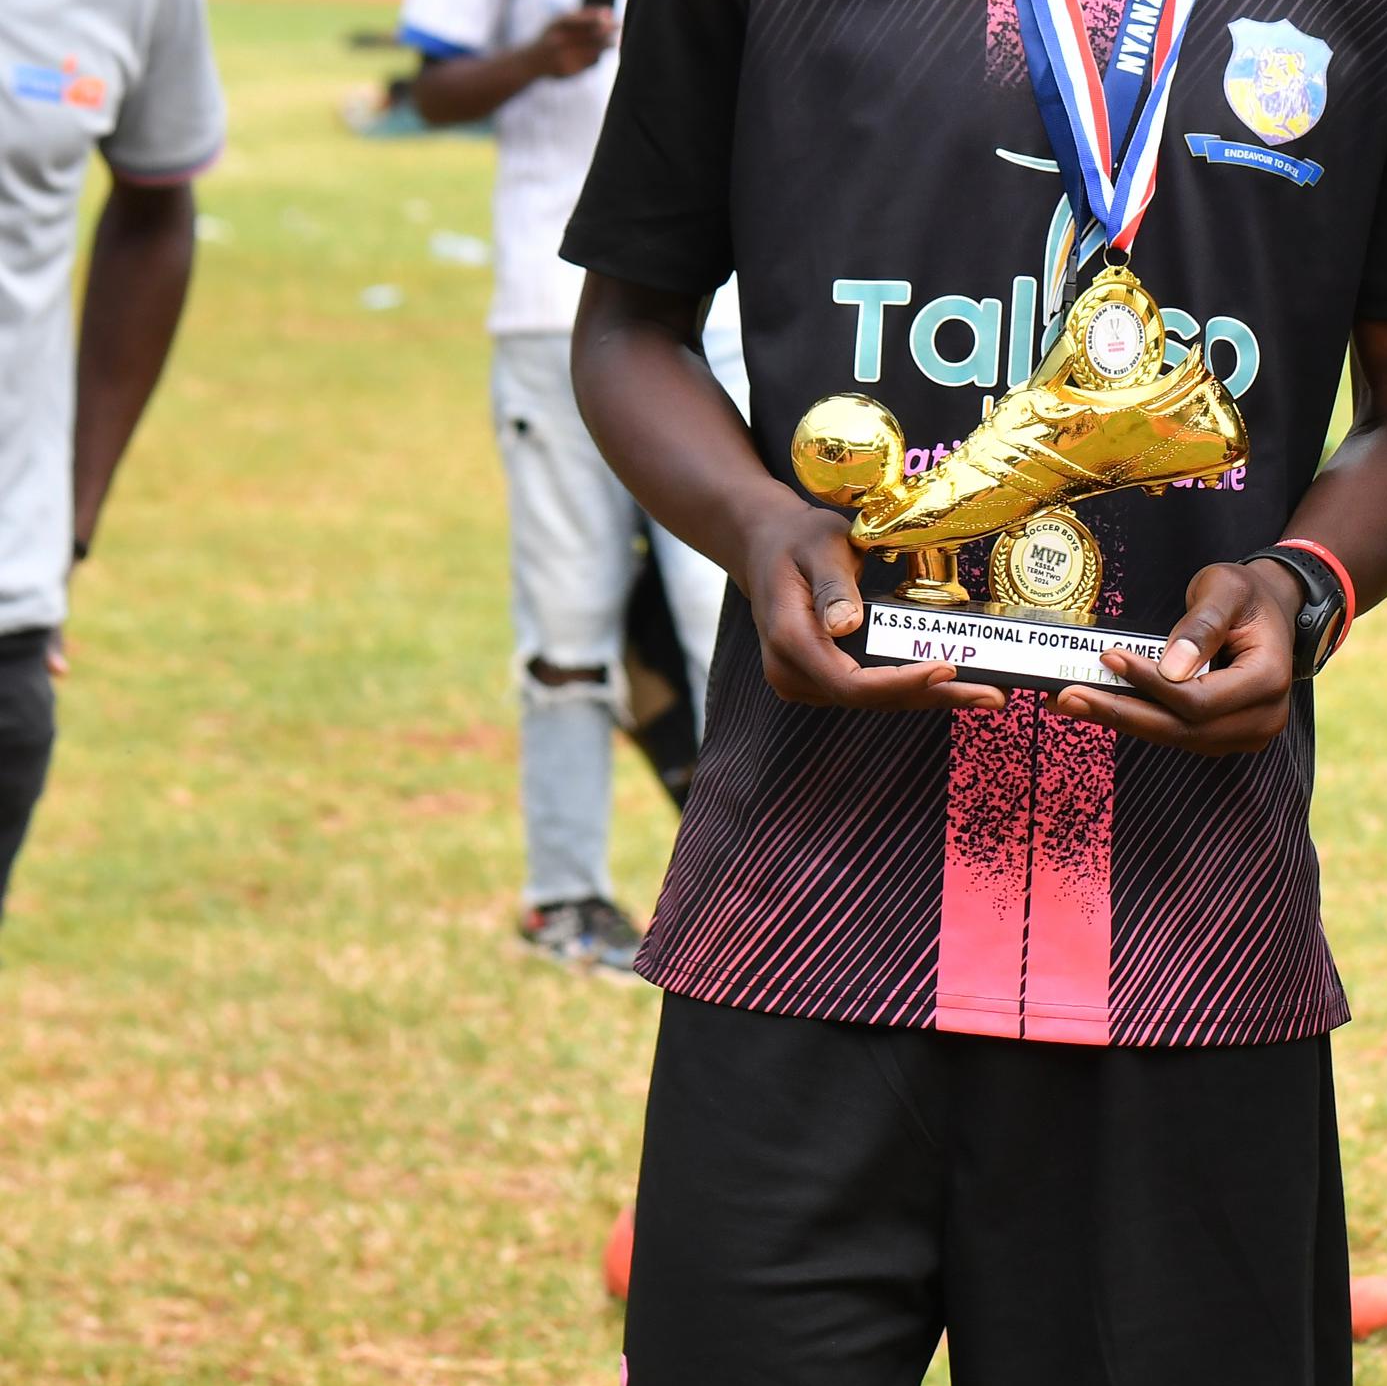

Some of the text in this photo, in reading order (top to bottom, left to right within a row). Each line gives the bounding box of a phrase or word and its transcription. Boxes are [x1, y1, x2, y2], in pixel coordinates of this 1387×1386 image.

[1224, 148, 1273, 165] ENDEAVOUR
[1274, 158, 1284, 169] TO
[1025, 523, 1080, 552] SOCCER BOYS
[1030, 544, 1067, 567] MVP
[1034, 561, 1055, 572] KSSSA
[1026, 566, 1061, 581] TERM TWO
[1034, 576, 1049, 585] 2024
[872, 611, 1024, 643] K.S.S.S.A-NATIONAL
[1028, 631, 1104, 653] FOOTBALL
[912, 639, 977, 663] M.V.P
